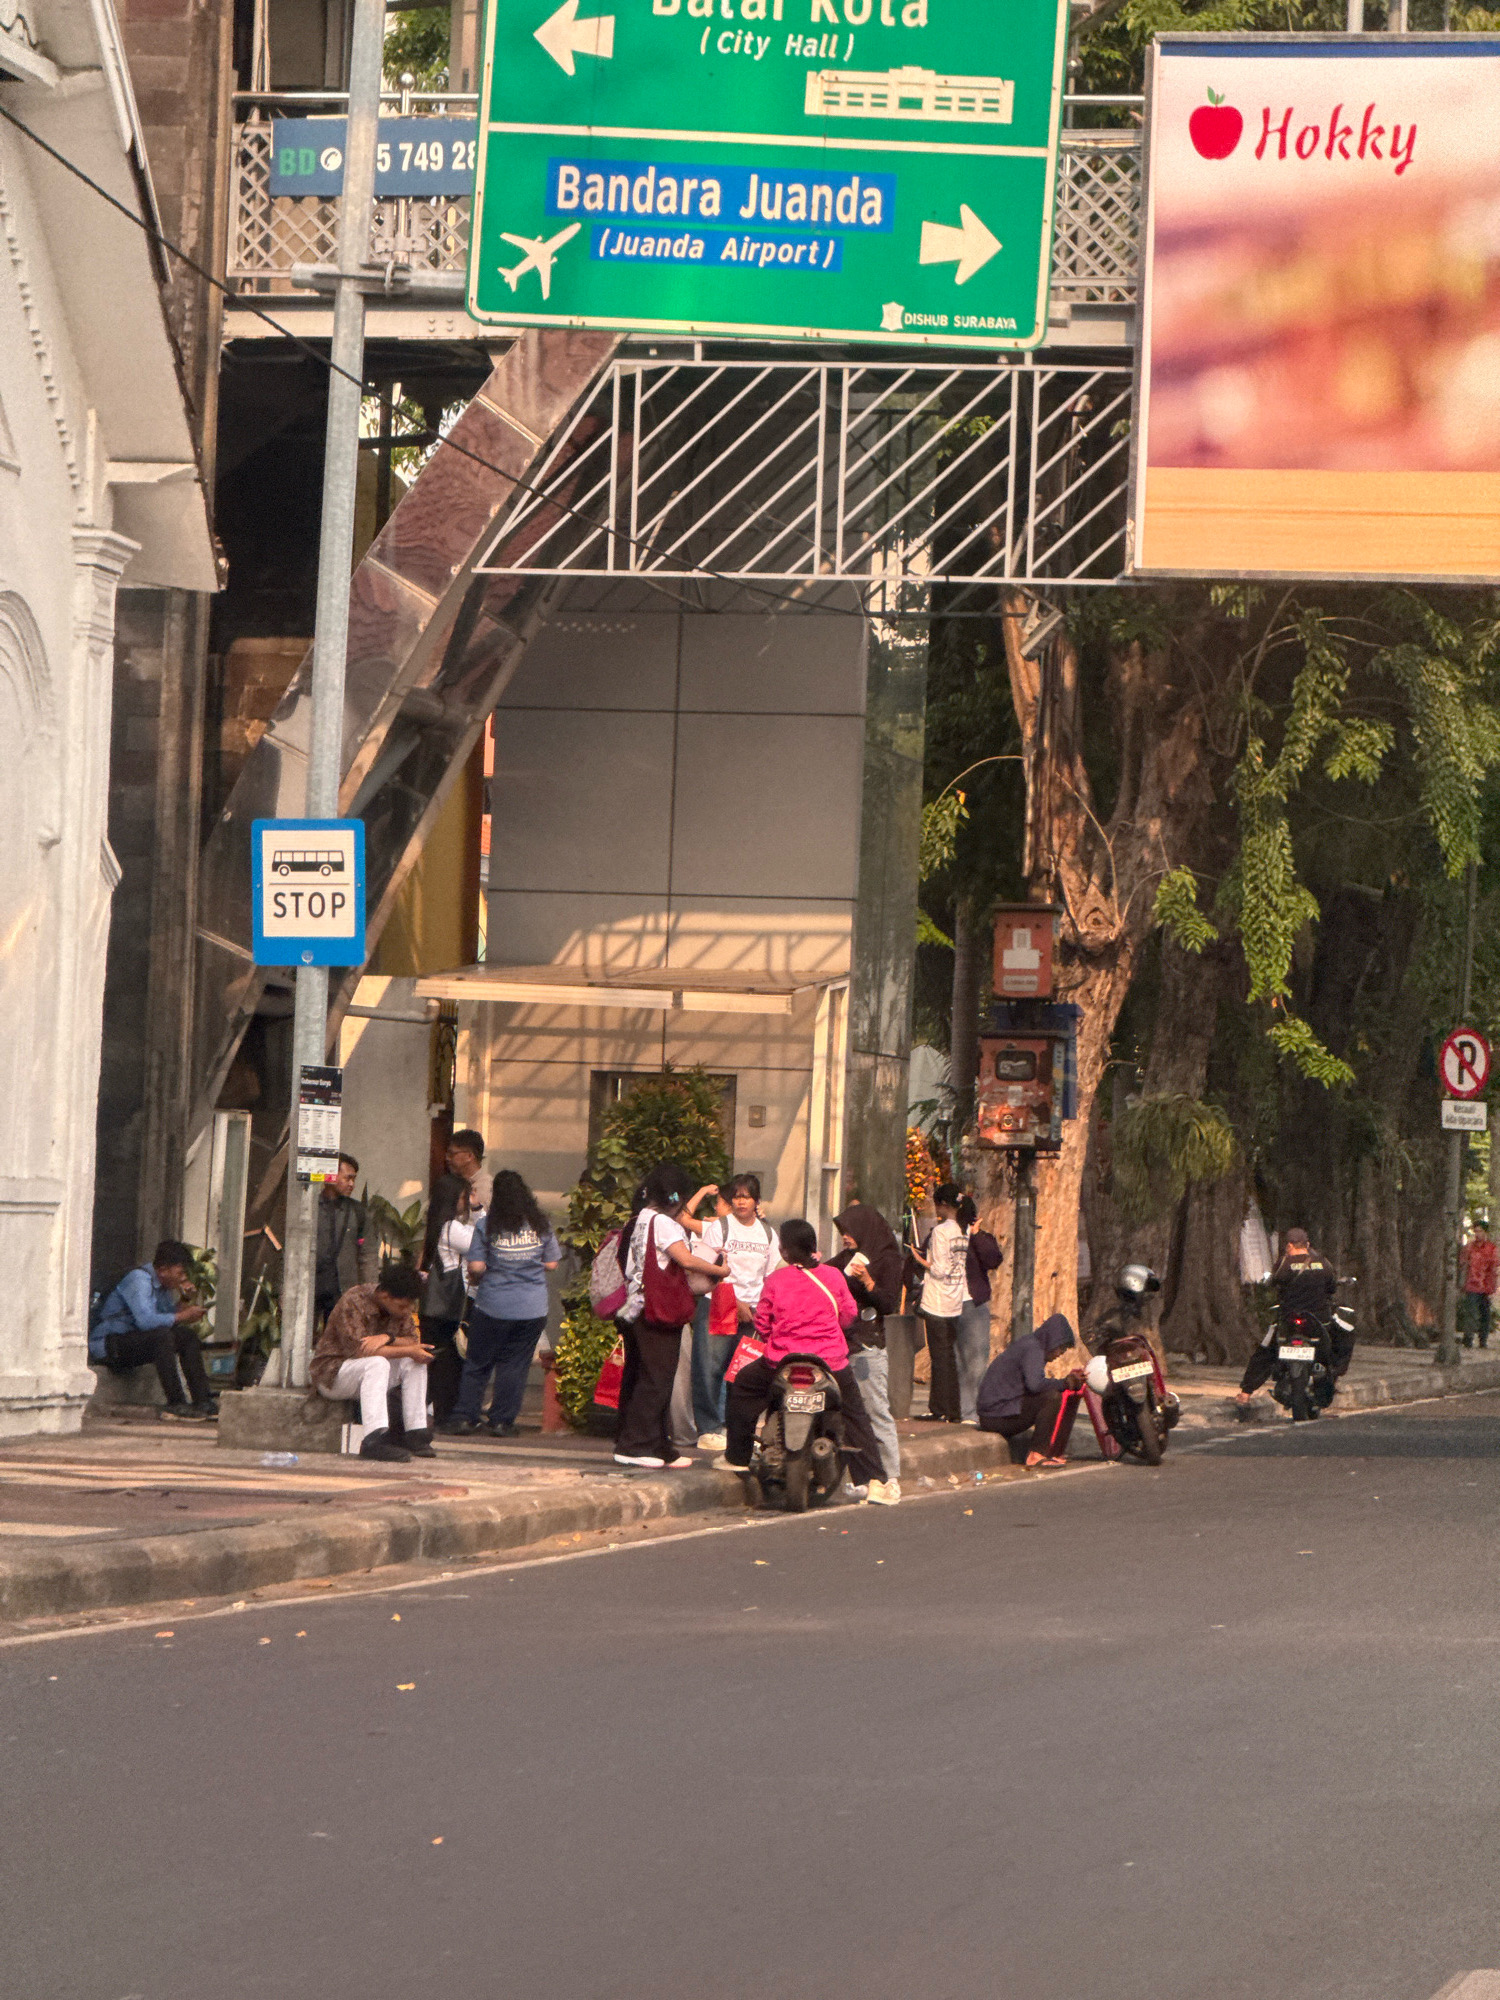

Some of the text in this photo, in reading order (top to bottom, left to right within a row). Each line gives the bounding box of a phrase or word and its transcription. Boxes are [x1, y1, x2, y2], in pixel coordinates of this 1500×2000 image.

[700, 26, 771, 60] (City
[398, 141, 443, 171] 749
[1255, 102, 1417, 176] Hokky
[557, 165, 882, 225] Bandara Juanda
[599, 228, 835, 269] (Juanda Airport)
[904, 312, 1017, 330] DISHUB SURABAYA
[273, 891, 347, 919] STOP
